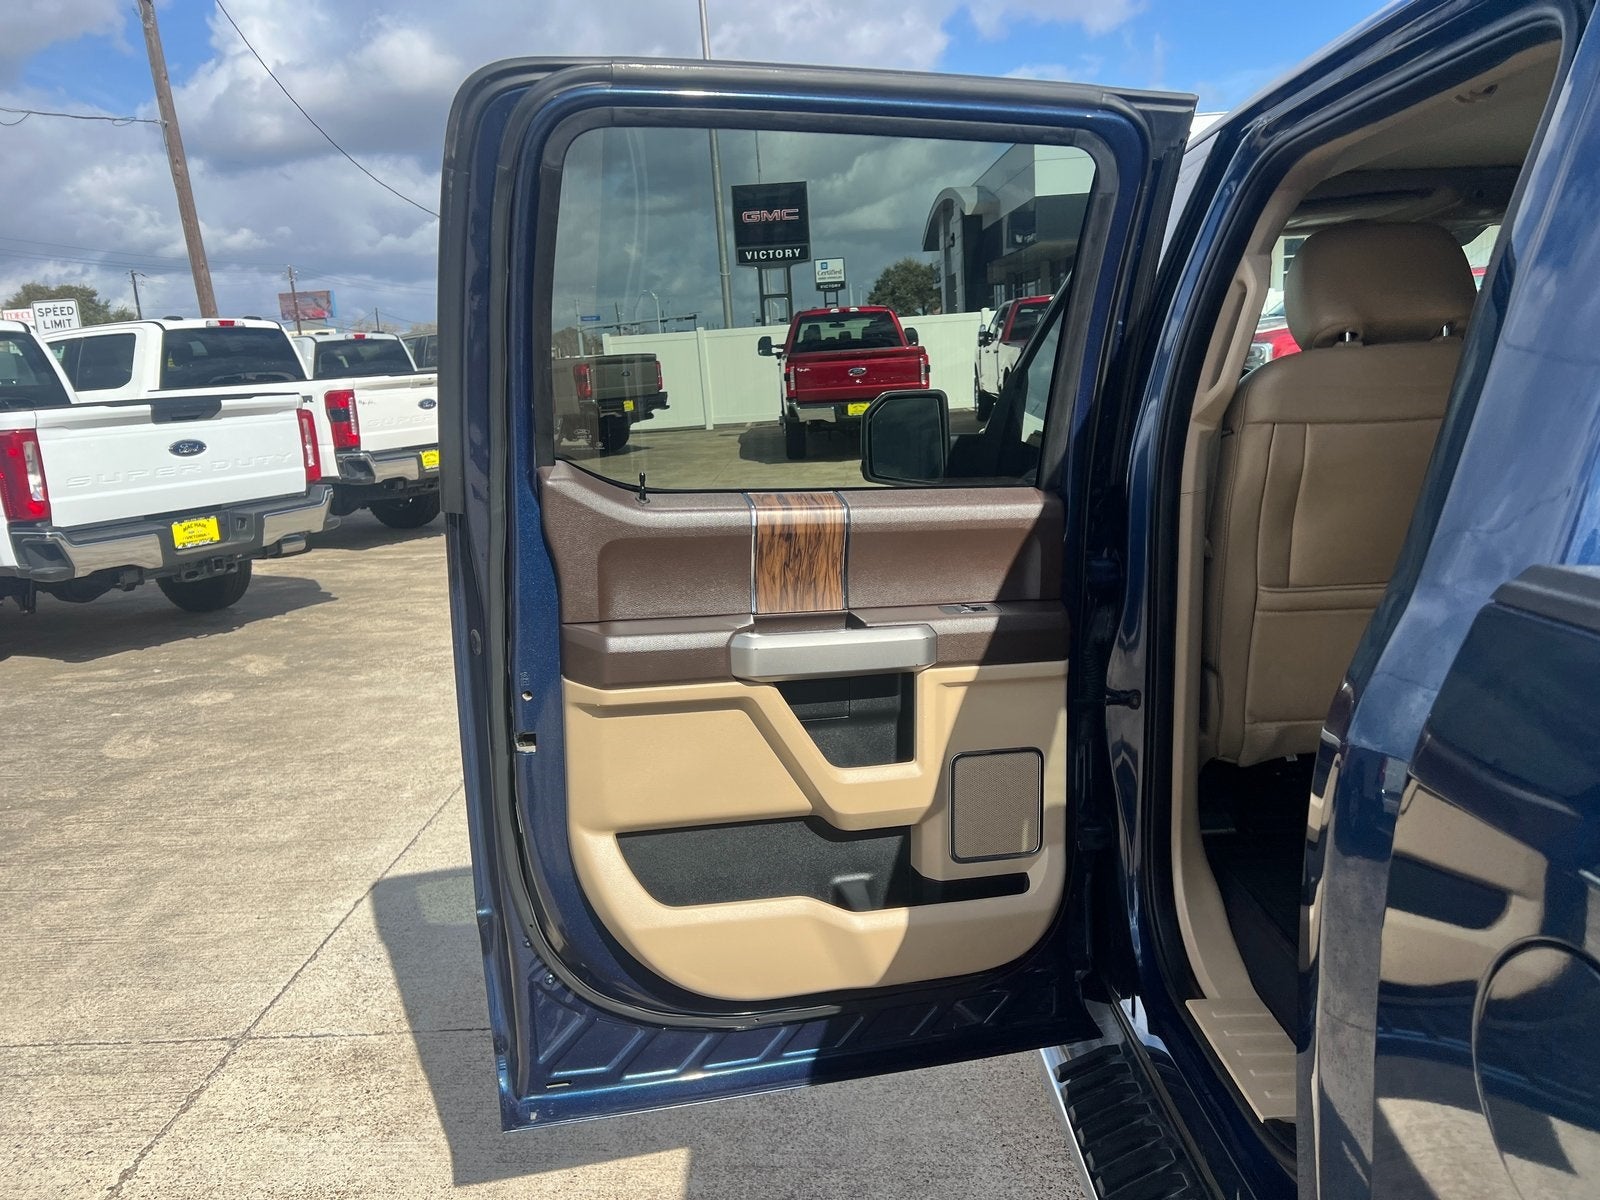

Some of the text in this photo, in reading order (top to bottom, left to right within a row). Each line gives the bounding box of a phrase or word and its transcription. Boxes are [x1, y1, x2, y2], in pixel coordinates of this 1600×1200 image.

[742, 208, 799, 223] GMC
[746, 248, 801, 260] VICTORY
[37, 306, 74, 317] SPEED
[43, 318, 72, 330] LIMIT
[66, 453, 293, 488] SUPER DUTY
